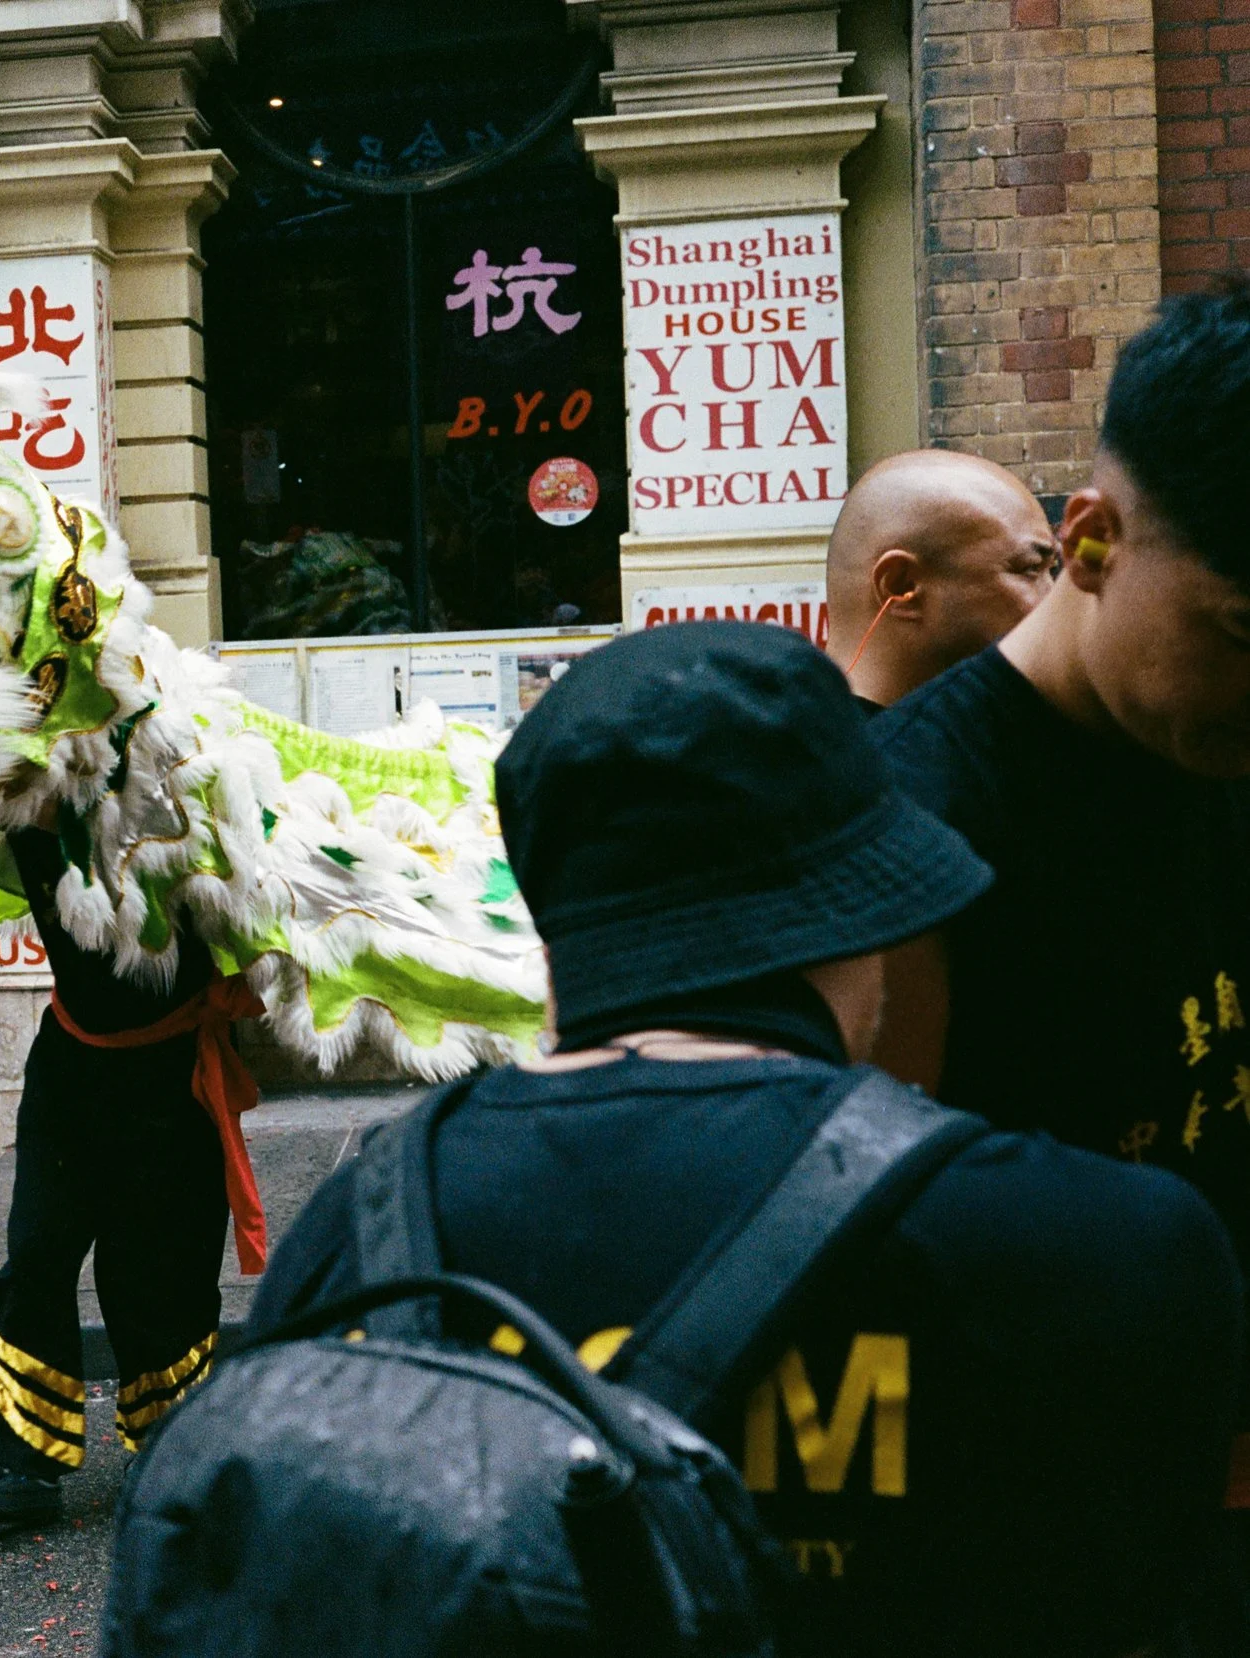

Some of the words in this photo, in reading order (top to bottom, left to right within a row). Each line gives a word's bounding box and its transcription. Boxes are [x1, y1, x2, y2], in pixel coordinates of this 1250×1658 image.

[627, 224, 833, 268] Shanghai
[445, 247, 582, 337] 杭
[629, 269, 839, 309] Dumpling
[664, 307, 807, 338] HOUSE
[636, 337, 840, 397] YUM
[447, 389, 592, 438] B.Y.O
[638, 396, 836, 453] CHA
[634, 466, 849, 510] SPECIAL
